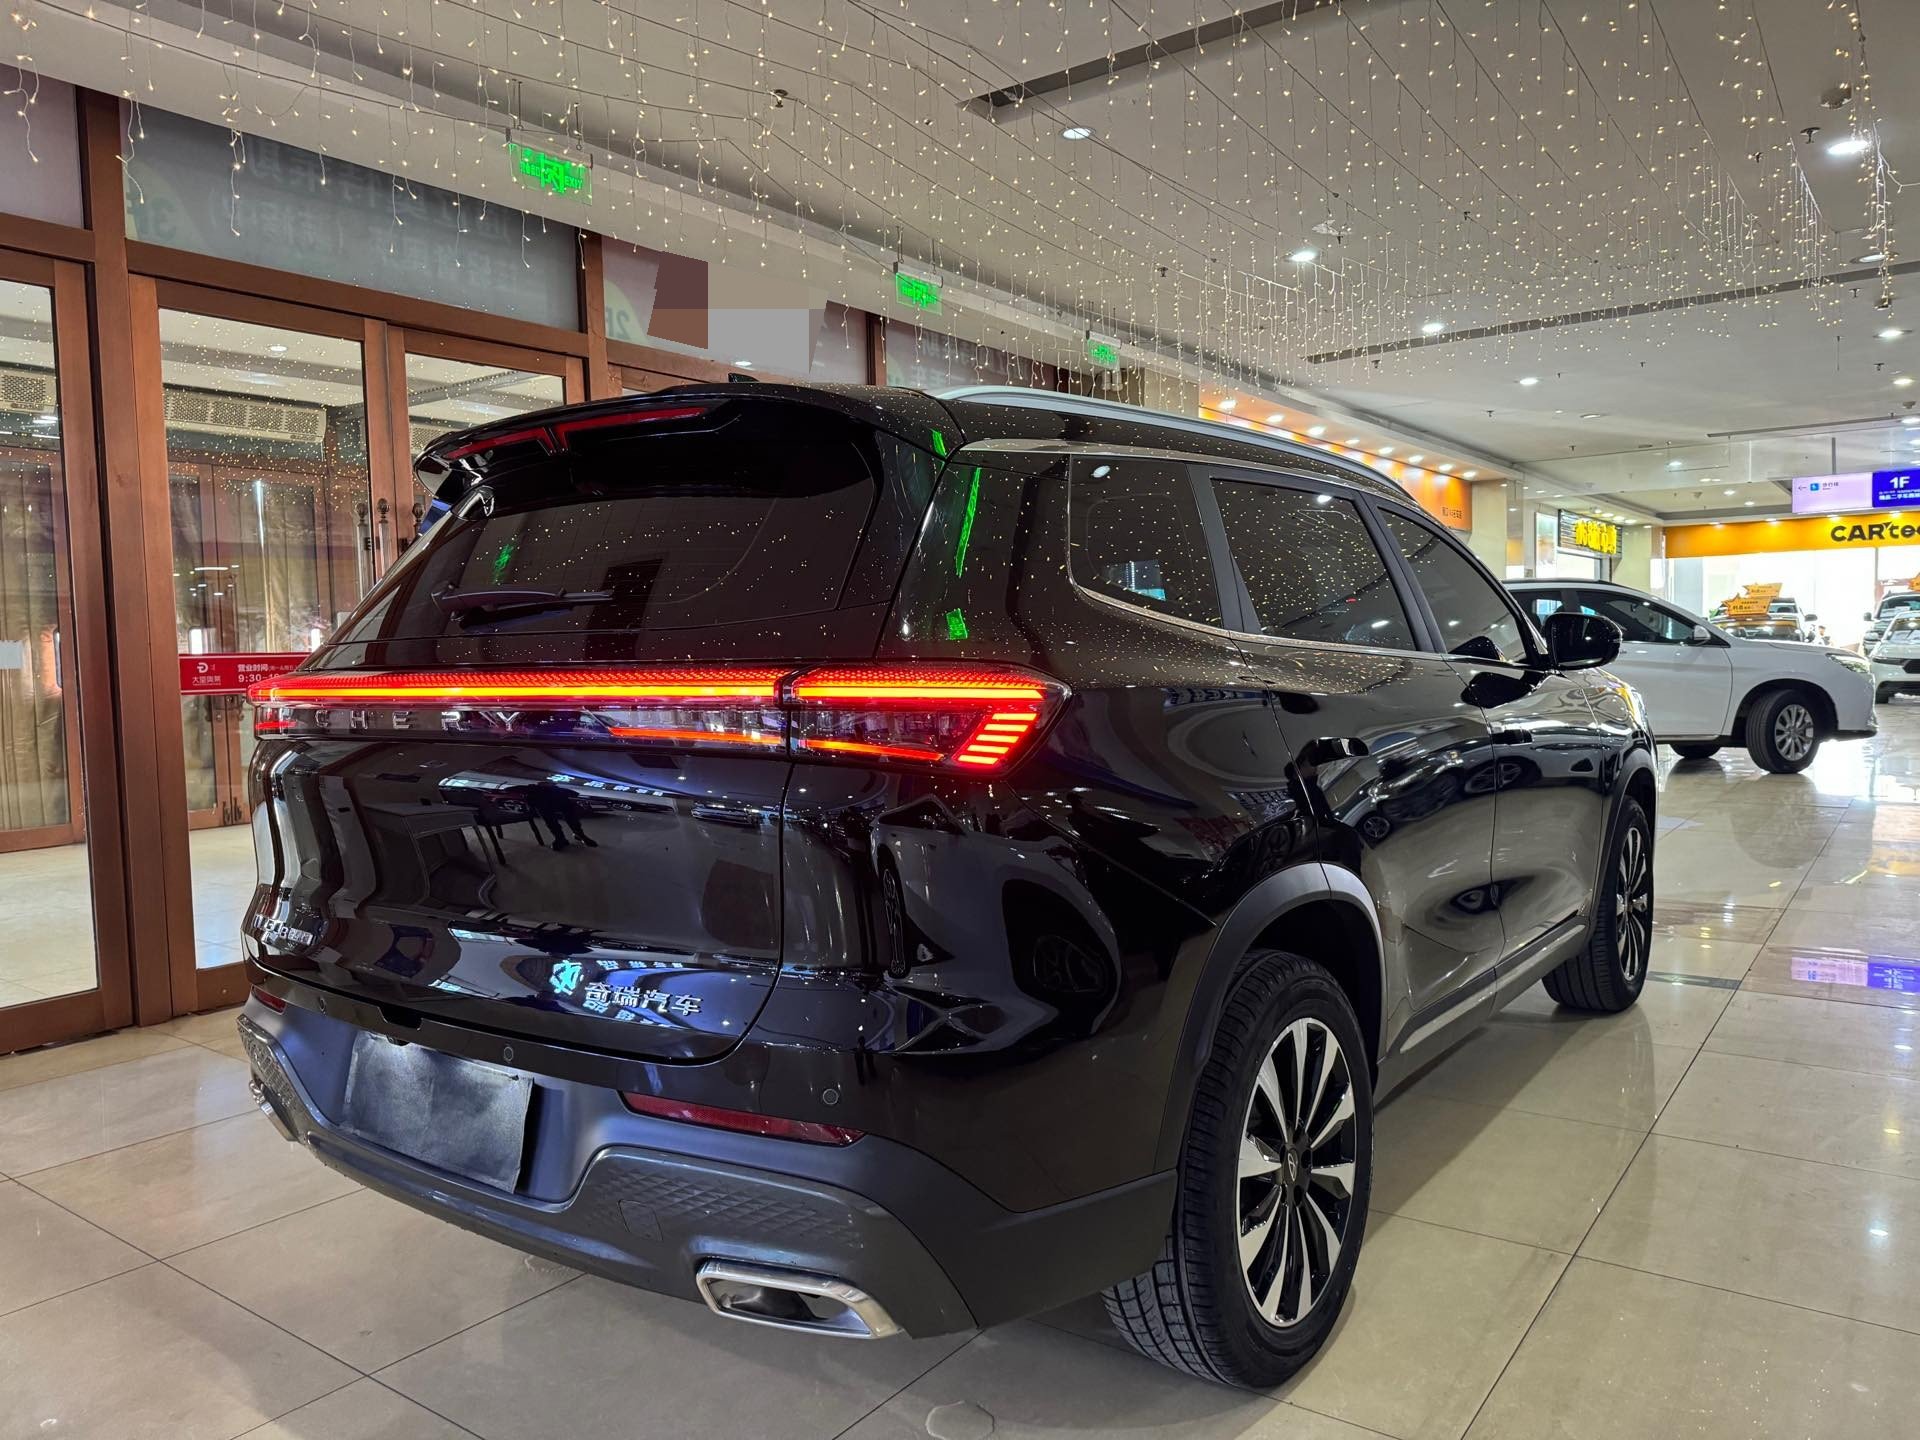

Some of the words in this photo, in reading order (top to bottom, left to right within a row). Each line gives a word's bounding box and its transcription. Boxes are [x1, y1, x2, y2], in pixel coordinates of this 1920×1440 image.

[1889, 476, 1910, 489] 1F
[314, 709, 521, 732] CHERY
[584, 982, 703, 1016] 奇瑞汽车
